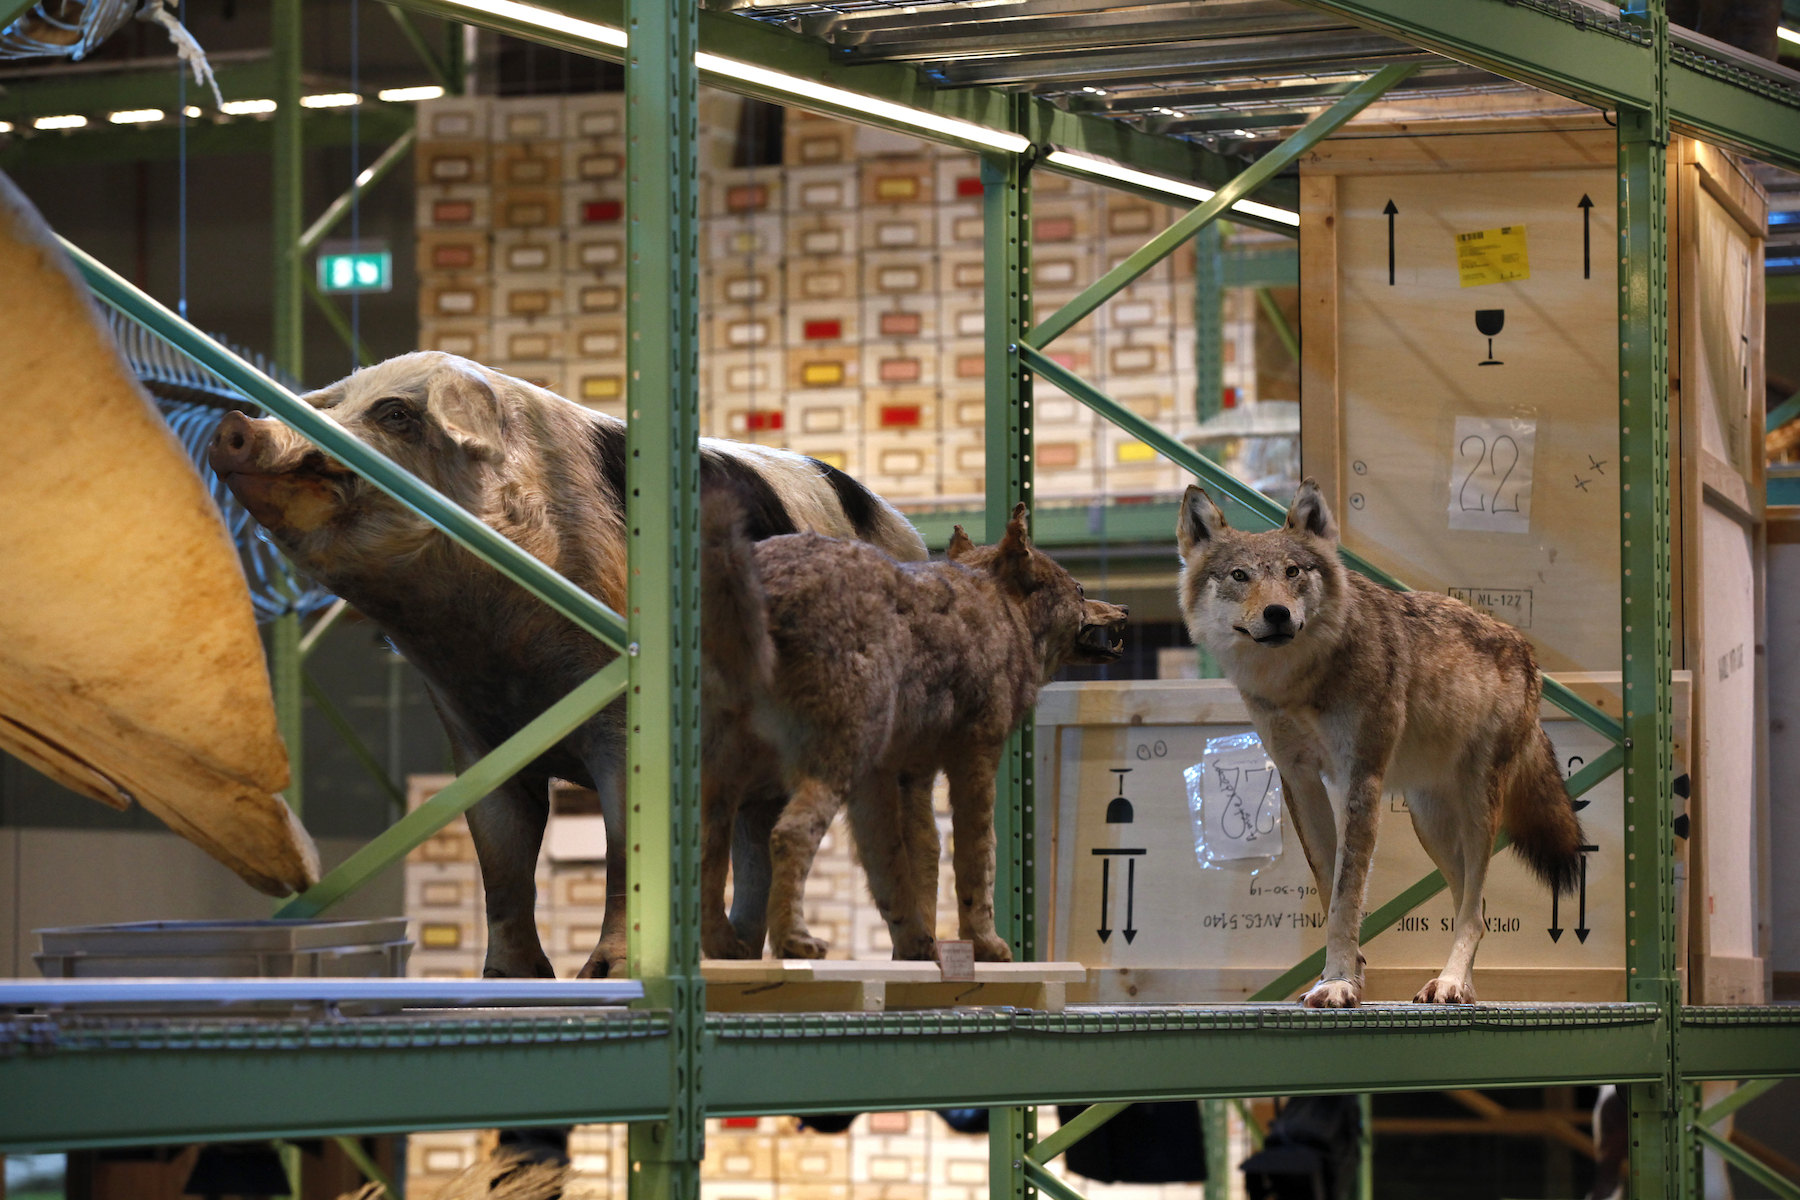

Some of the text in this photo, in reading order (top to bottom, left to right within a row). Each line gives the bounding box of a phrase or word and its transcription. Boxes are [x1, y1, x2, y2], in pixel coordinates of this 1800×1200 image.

[1459, 434, 1519, 514] 22
[1203, 913, 1238, 929] 5140
[1241, 913, 1283, 928] AVES.
